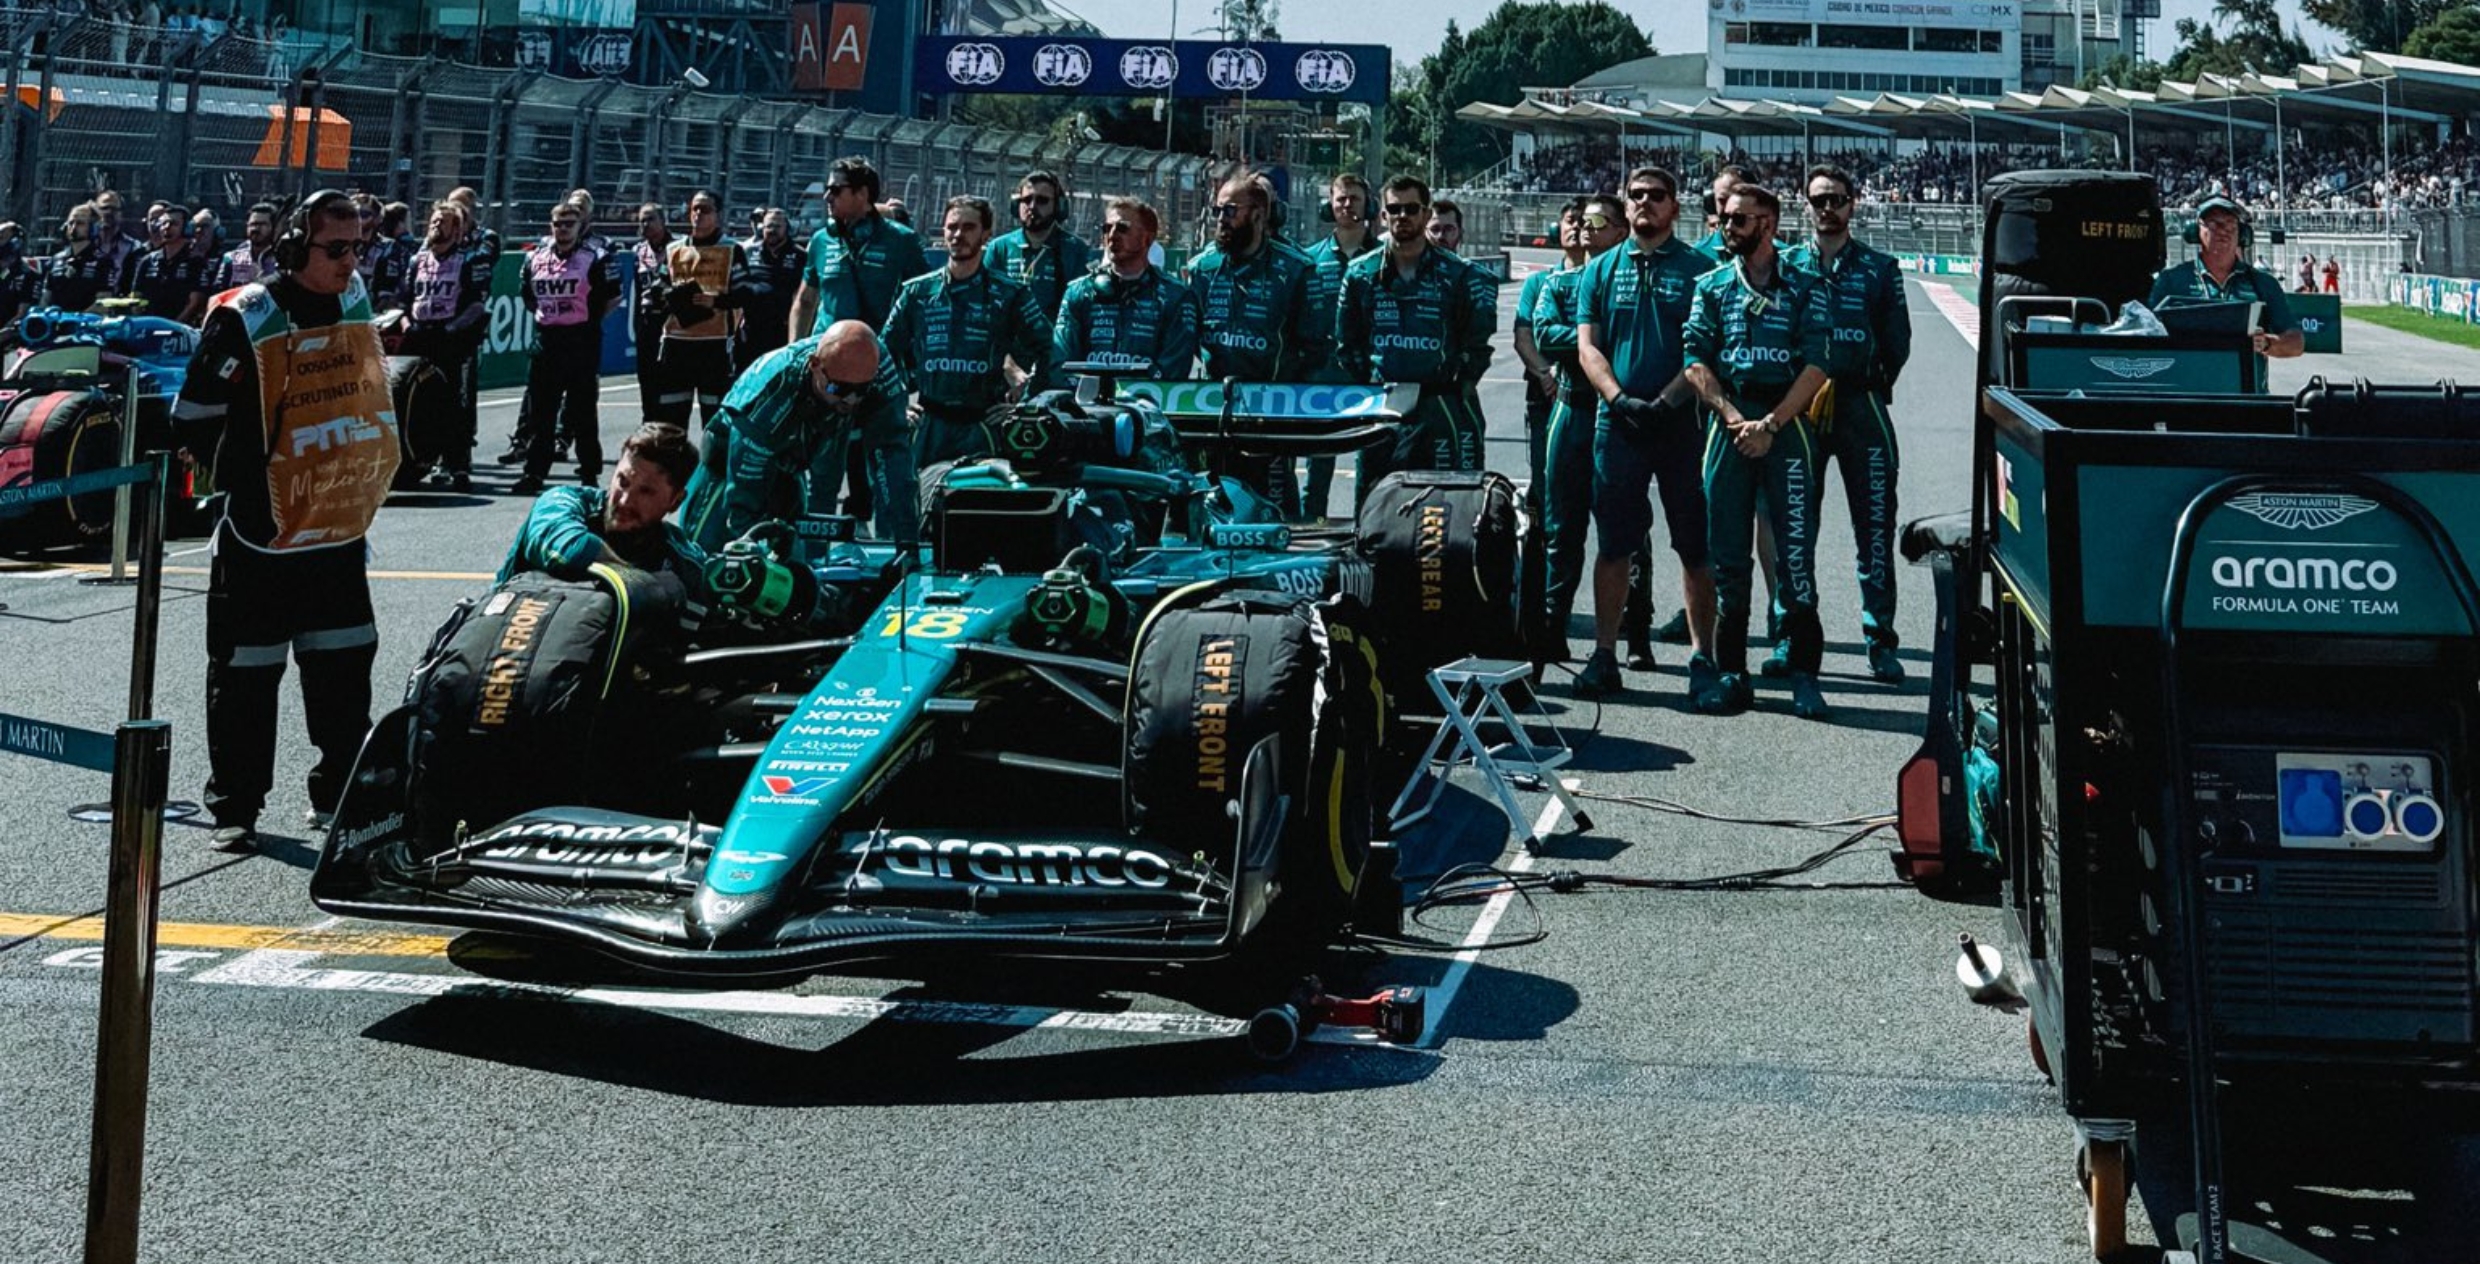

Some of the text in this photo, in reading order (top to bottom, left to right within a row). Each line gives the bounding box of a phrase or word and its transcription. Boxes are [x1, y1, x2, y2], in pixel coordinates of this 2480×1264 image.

[831, 24, 862, 63] A
[2082, 221, 2112, 237] LEFT
[536, 279, 579, 296] BWT
[1202, 331, 1267, 351] aramco
[1374, 334, 1441, 351] aramco
[1720, 346, 1790, 363] aramco
[925, 357, 989, 374] aramco
[0, 487, 26, 505] STON
[2263, 497, 2338, 509] ASTON MARTIN
[1785, 458, 1812, 604] ASTON MARTIN
[1868, 447, 1885, 590] ASTON MARTIN
[1216, 530, 1267, 546] BOSS
[1275, 566, 1324, 595] BOSS
[1421, 557, 1442, 611] REAR
[2211, 556, 2397, 591] aramco
[2212, 596, 2400, 615] FORMULA ONE TEAM
[501, 597, 550, 652] FRONT
[880, 611, 969, 639] 18
[803, 709, 893, 722] xerox
[813, 695, 902, 709] NexGen
[1198, 640, 1235, 792] LEFT FRONT
[7, 723, 65, 755] MARTIN
[790, 724, 880, 739] NetApp
[348, 811, 405, 848] Bombardier
[884, 835, 1170, 888] aramco
[2209, 1194, 2221, 1227] TEAM
[2211, 1229, 2223, 1260] RACE
